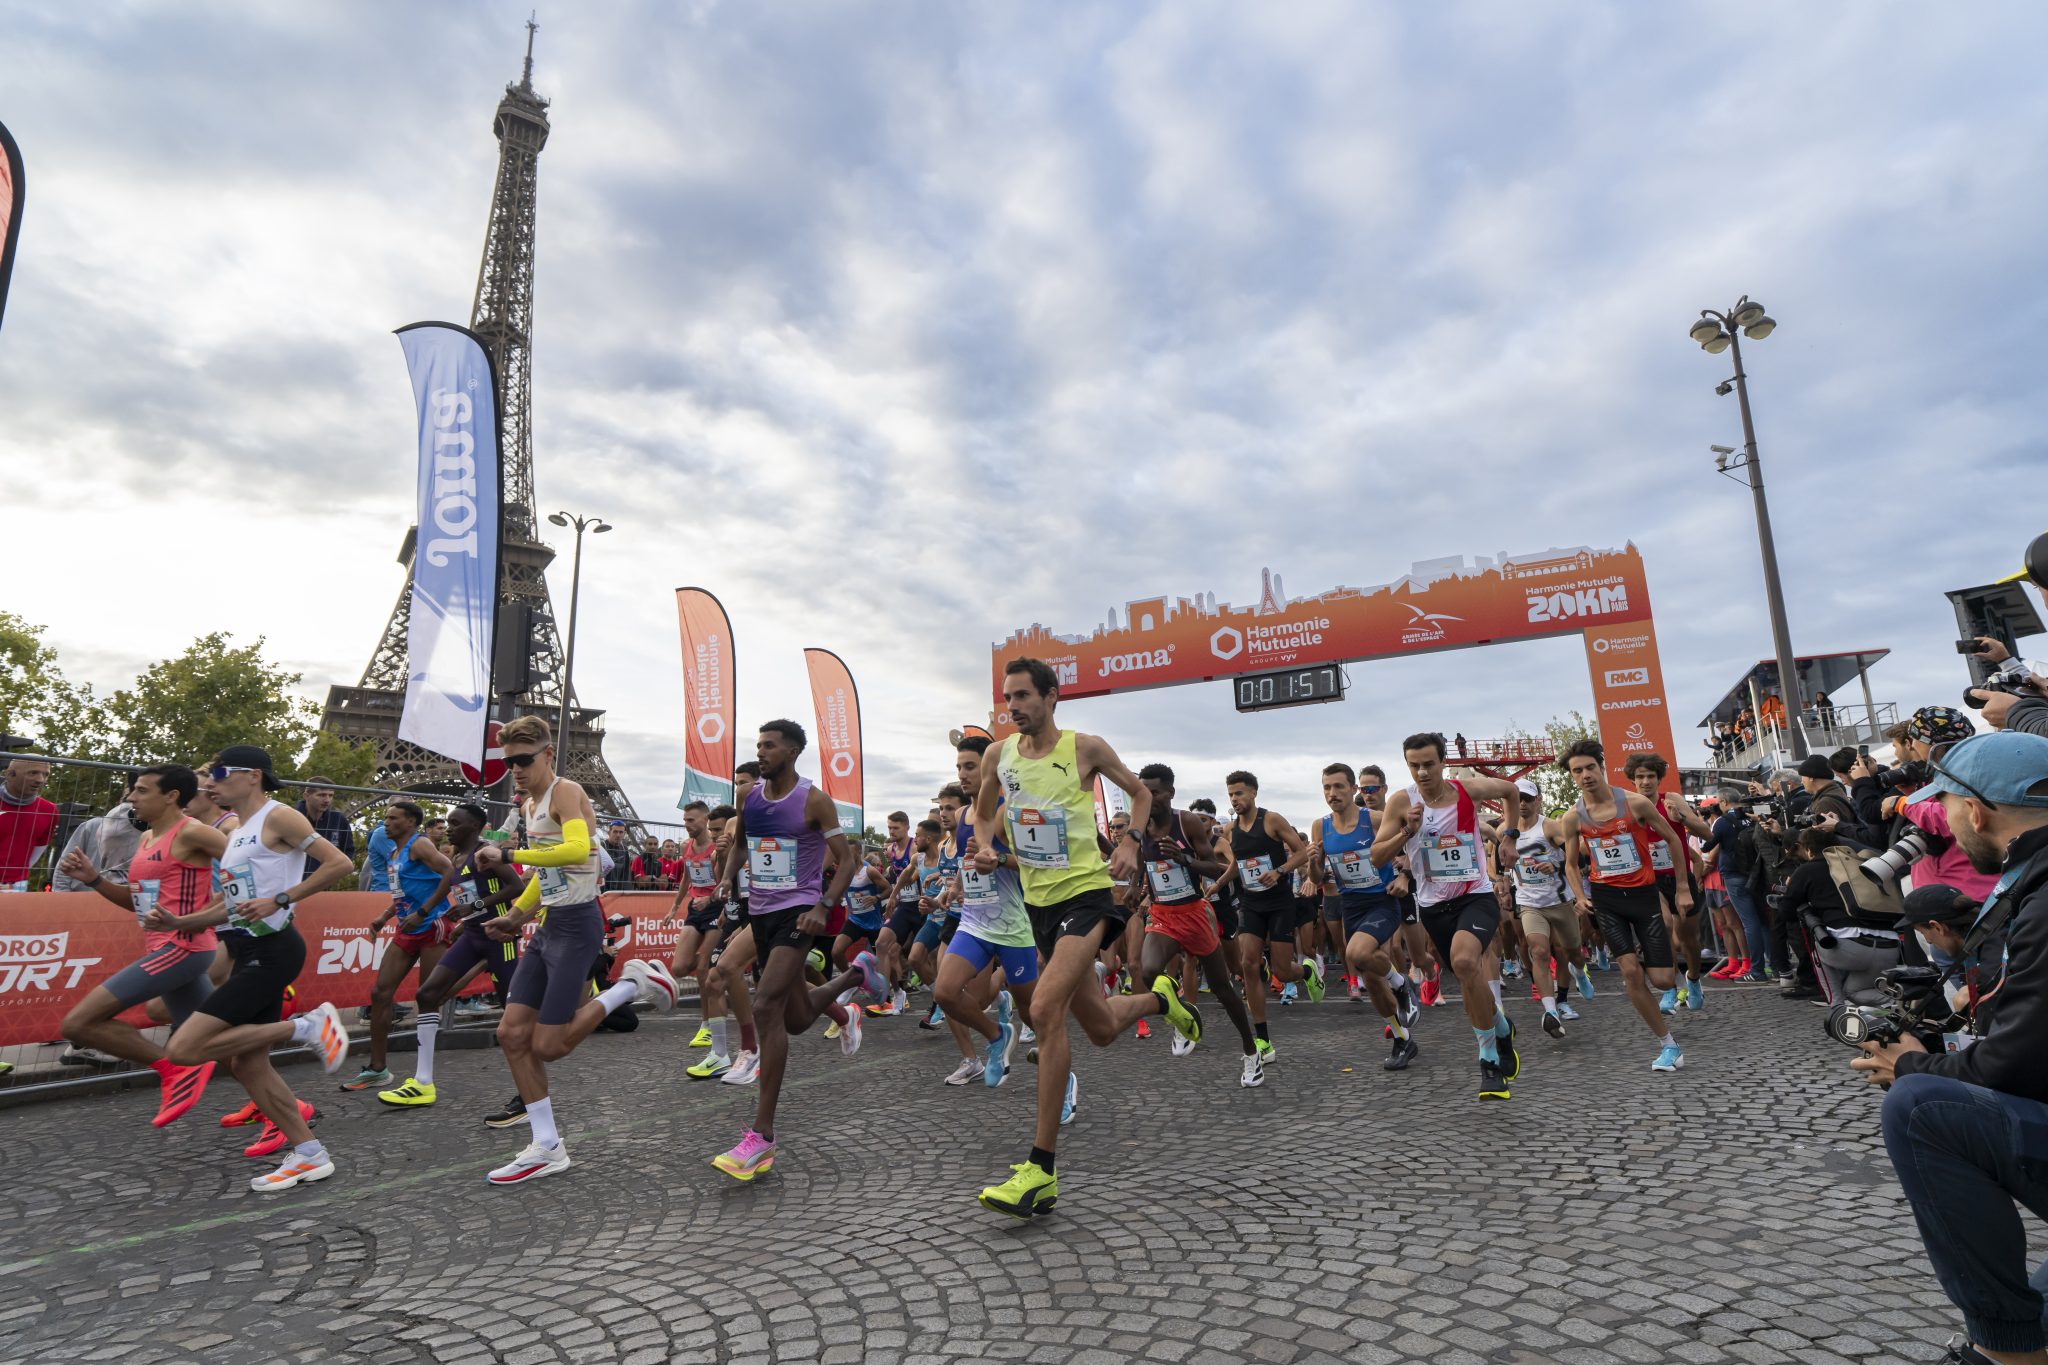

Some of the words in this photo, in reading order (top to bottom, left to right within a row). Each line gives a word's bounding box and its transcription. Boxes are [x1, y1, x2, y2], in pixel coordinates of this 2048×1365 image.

[1525, 582, 1576, 595] Harmonie
[1577, 576, 1624, 588] Mutuelle
[1527, 585, 1627, 622] 20KM
[1611, 601, 1629, 612] PARIS
[1247, 616, 1330, 639] Harmonie
[1248, 633, 1323, 653] Mutuelle
[1610, 635, 1649, 646] Harmonie
[1611, 642, 1646, 651] Mutuelle
[1045, 654, 1077, 664] Mutuelle
[1281, 653, 1297, 662] vyv
[1611, 671, 1644, 684] RMC
[1602, 698, 1661, 710] CAMPUS
[1622, 742, 1653, 751] PARIS
[1009, 783, 1020, 791] 92
[1028, 828, 1036, 841] 1
[1441, 850, 1460, 861] 18
[1604, 848, 1621, 858] 82
[763, 854, 772, 866] 3
[1248, 868, 1261, 877] 73
[1346, 863, 1360, 873] 57
[965, 871, 979, 883] 14
[1162, 873, 1170, 883] 9
[323, 926, 369, 936] Harmon
[635, 932, 680, 946] Mutue
